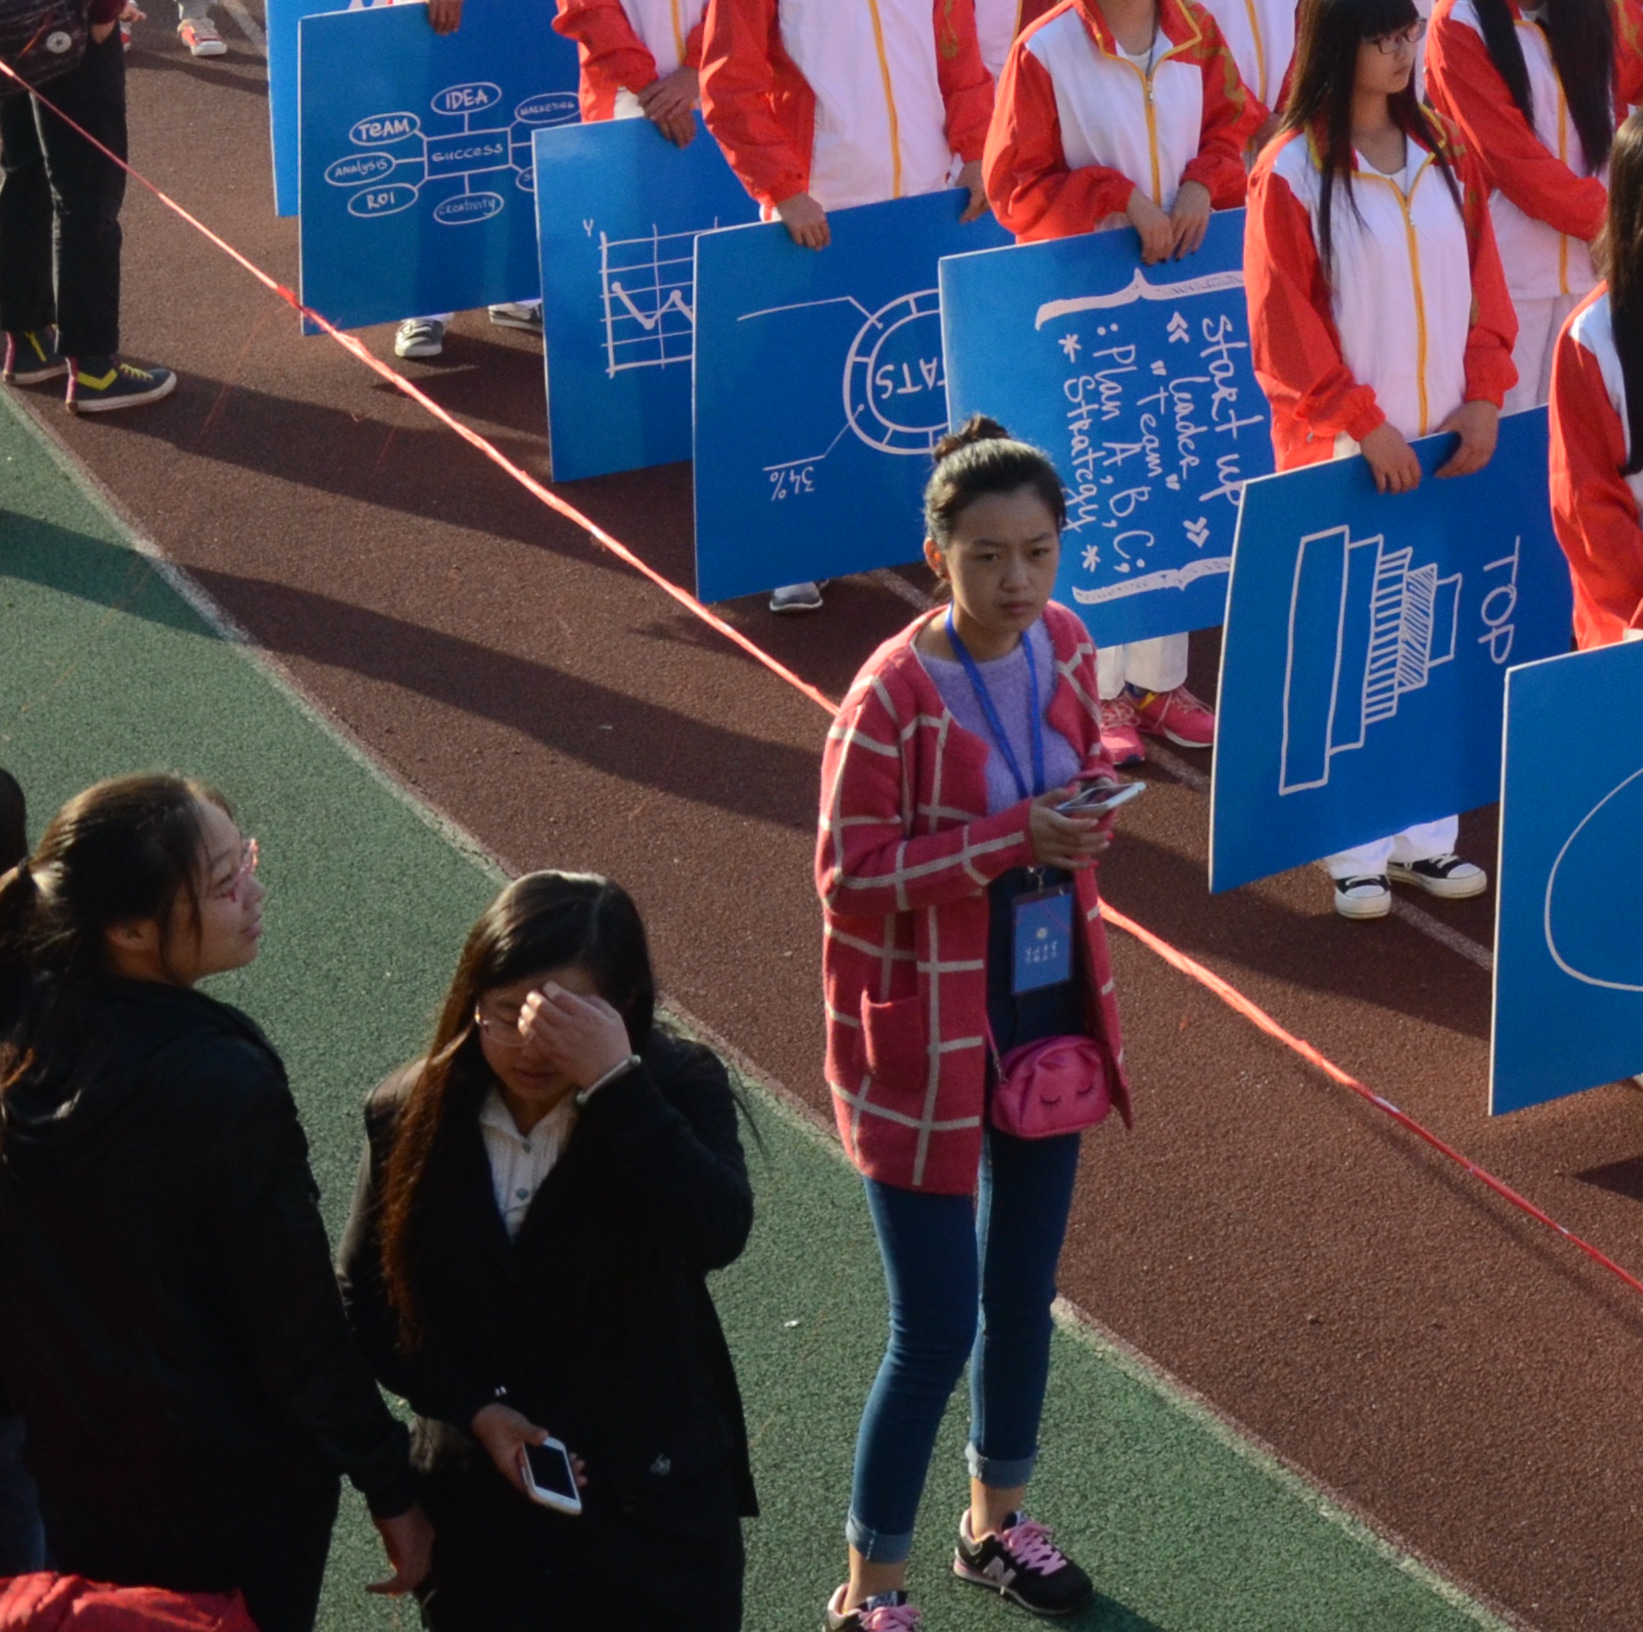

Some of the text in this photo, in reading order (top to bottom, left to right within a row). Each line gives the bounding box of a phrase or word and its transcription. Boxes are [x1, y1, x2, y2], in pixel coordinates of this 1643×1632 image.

[445, 89, 489, 110] IDEA
[366, 191, 395, 210] ROI
[874, 357, 945, 399] ATS
[768, 466, 815, 502] 34%
[1478, 535, 1520, 664] TOP
